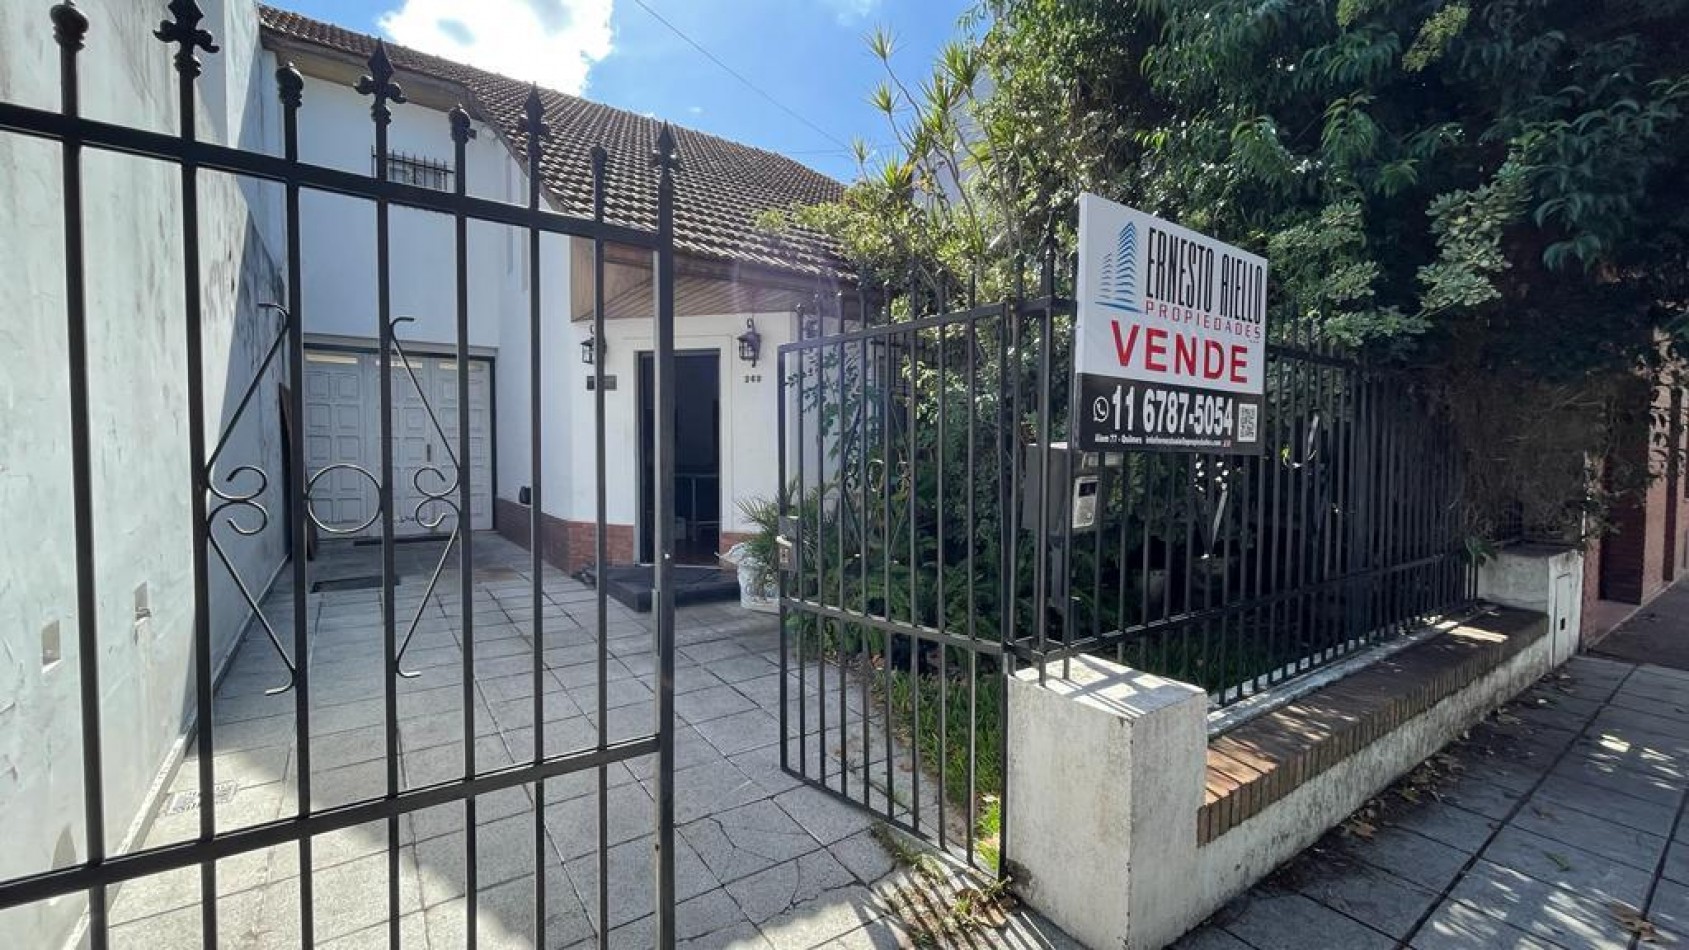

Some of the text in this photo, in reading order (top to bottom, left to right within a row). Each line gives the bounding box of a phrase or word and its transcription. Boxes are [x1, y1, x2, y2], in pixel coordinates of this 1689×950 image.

[1146, 227, 1263, 324] ERNESTO AIELLO
[1145, 301, 1261, 339] PROPIEDADES
[1111, 319, 1248, 384] VENDE
[1112, 384, 1233, 437] 11 6787-5054
